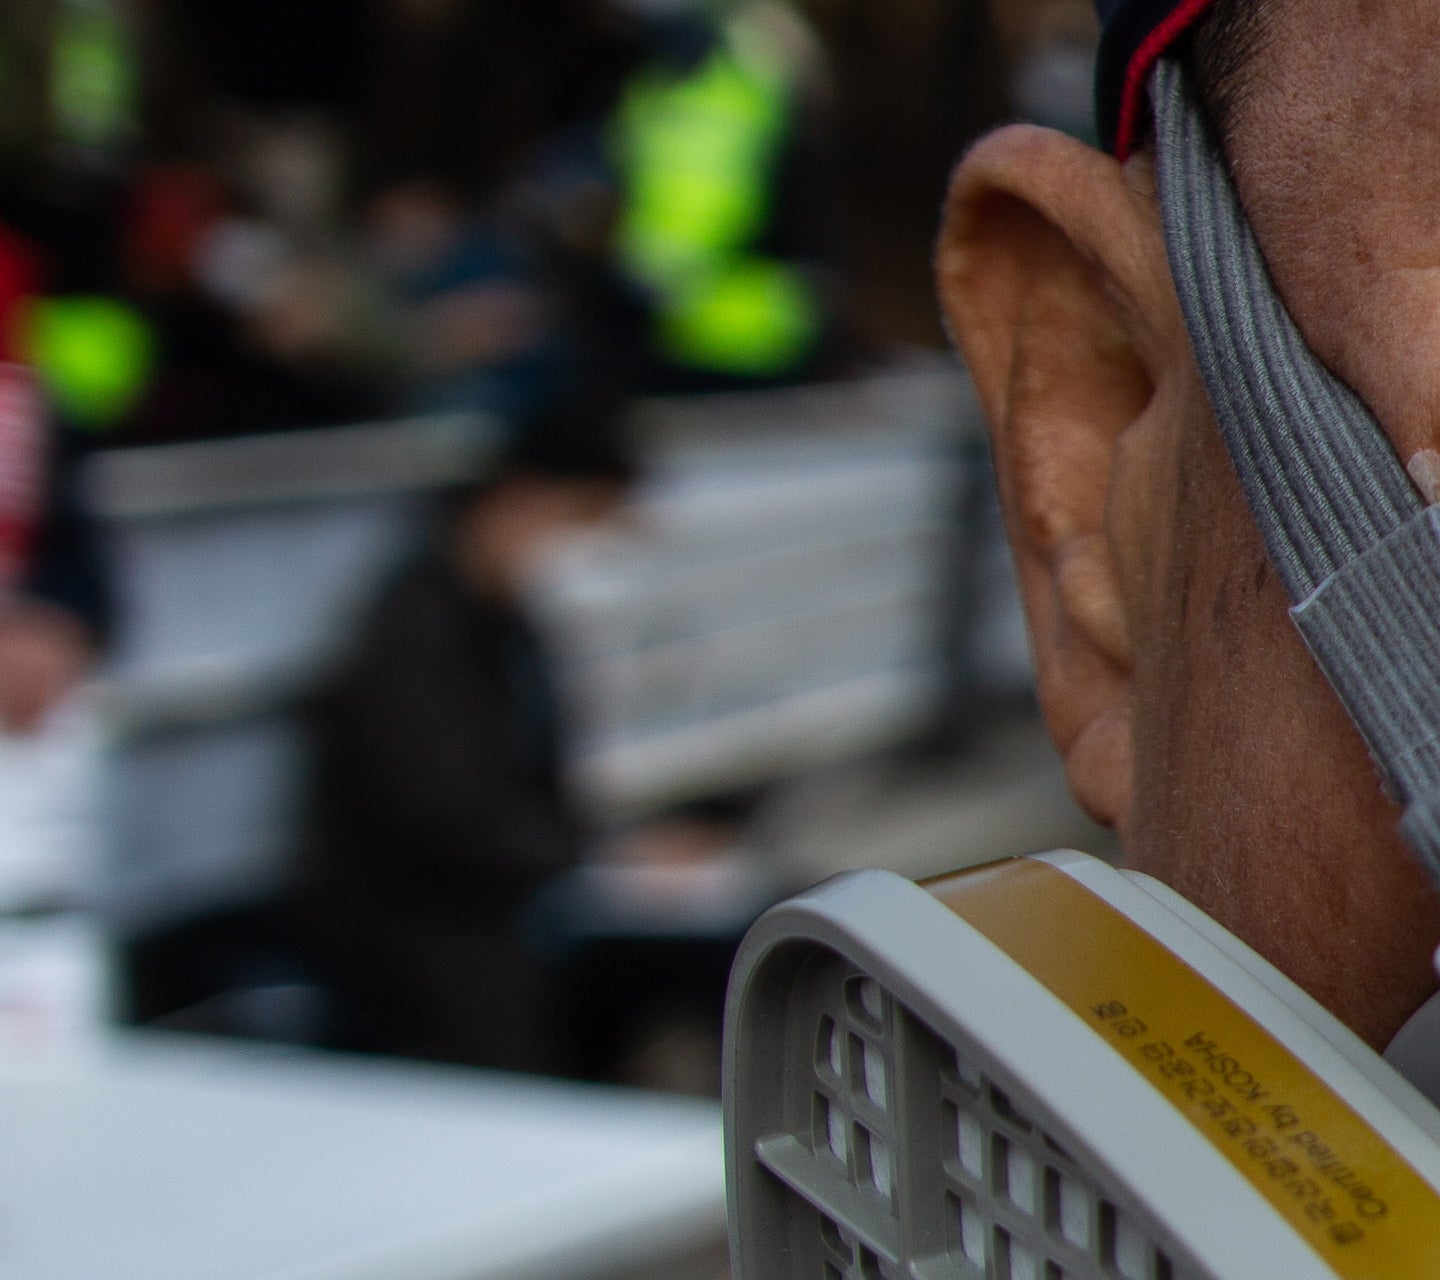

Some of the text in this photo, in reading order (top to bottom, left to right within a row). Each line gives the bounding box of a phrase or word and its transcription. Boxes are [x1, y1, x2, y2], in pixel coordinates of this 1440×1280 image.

[1091, 997, 1146, 1041] 인증
[1183, 1029, 1390, 1222] Certified by KOSHA
